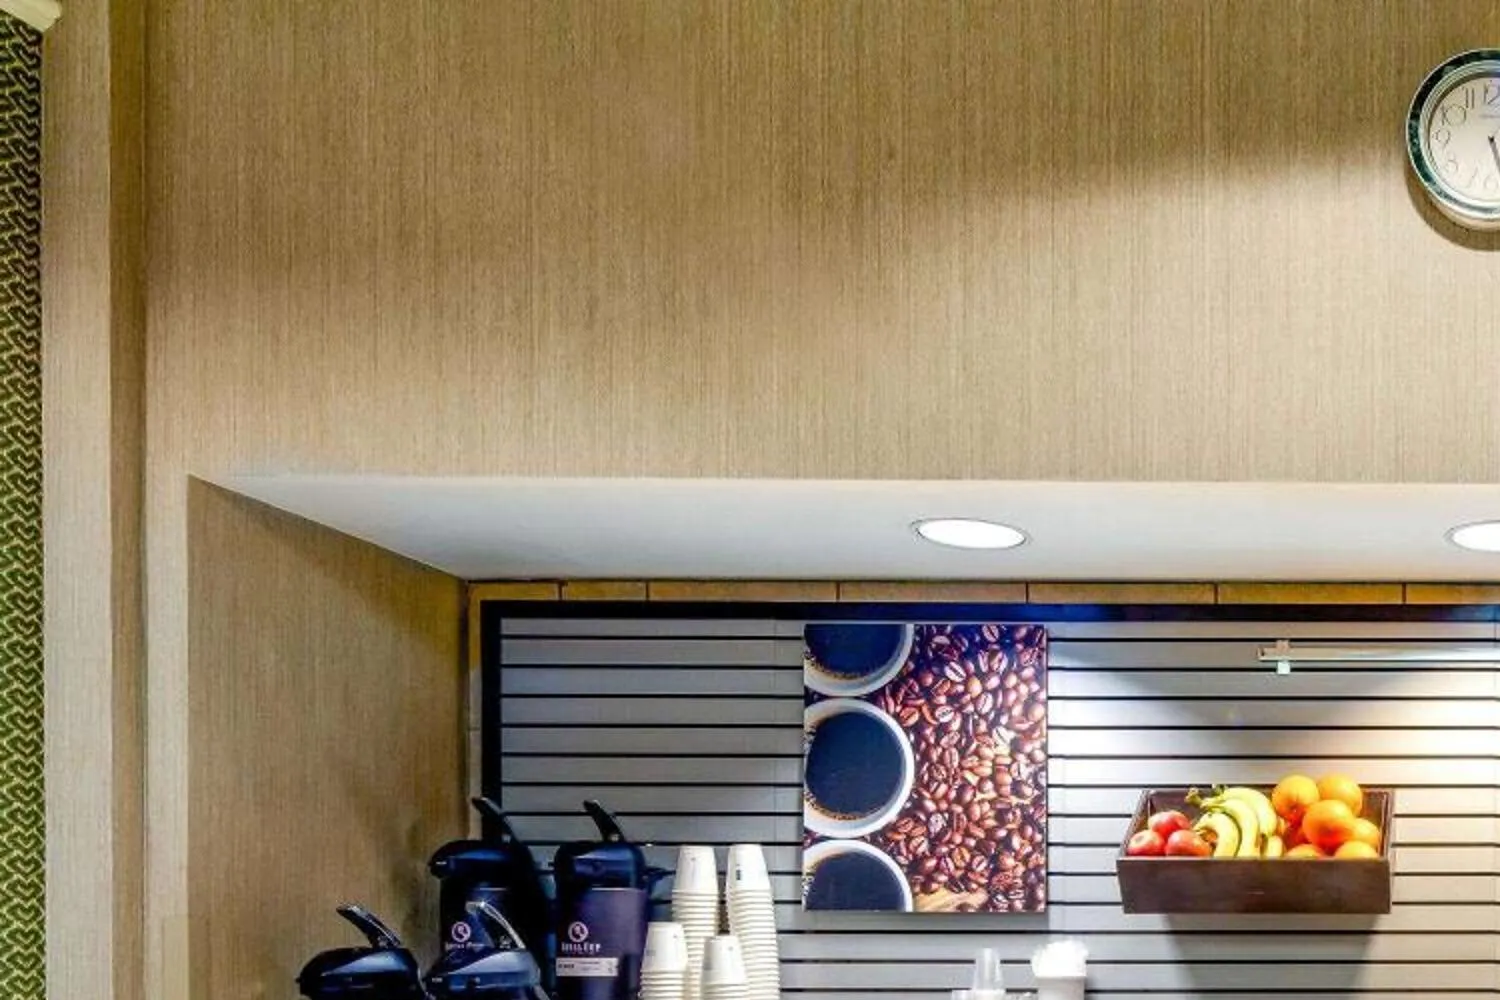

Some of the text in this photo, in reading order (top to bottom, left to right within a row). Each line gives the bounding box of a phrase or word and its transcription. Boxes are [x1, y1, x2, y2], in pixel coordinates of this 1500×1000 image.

[1465, 87, 1474, 109] 11
[1484, 82, 1500, 105] 12
[1441, 103, 1467, 126] 10
